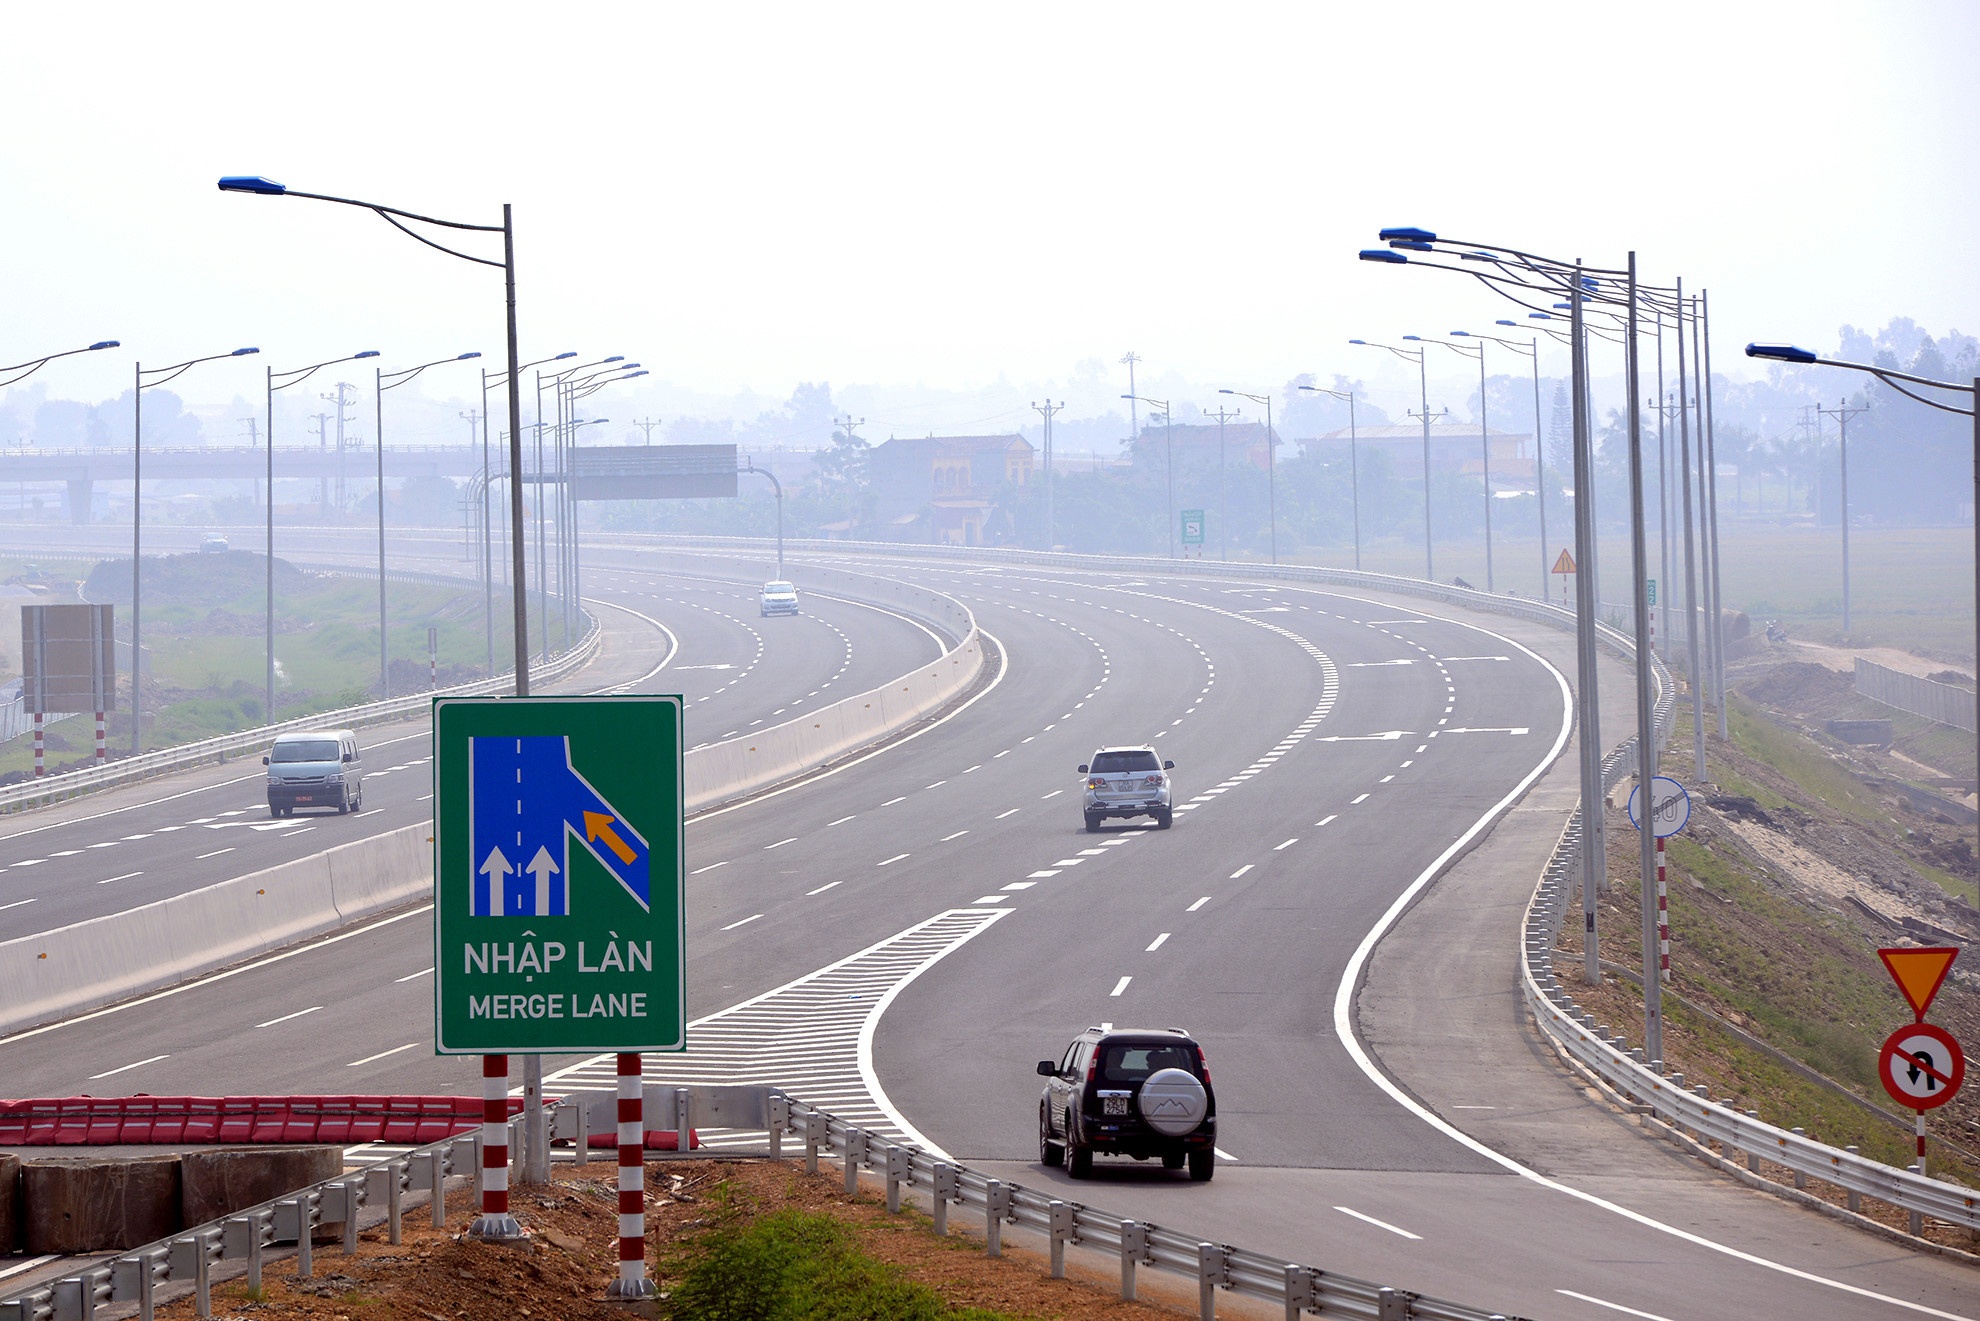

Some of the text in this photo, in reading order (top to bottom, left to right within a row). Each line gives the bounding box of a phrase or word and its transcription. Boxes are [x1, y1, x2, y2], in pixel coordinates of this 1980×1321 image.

[464, 930, 653, 982] NHẬP LÀN
[469, 993, 648, 1020] MERGE LANE
